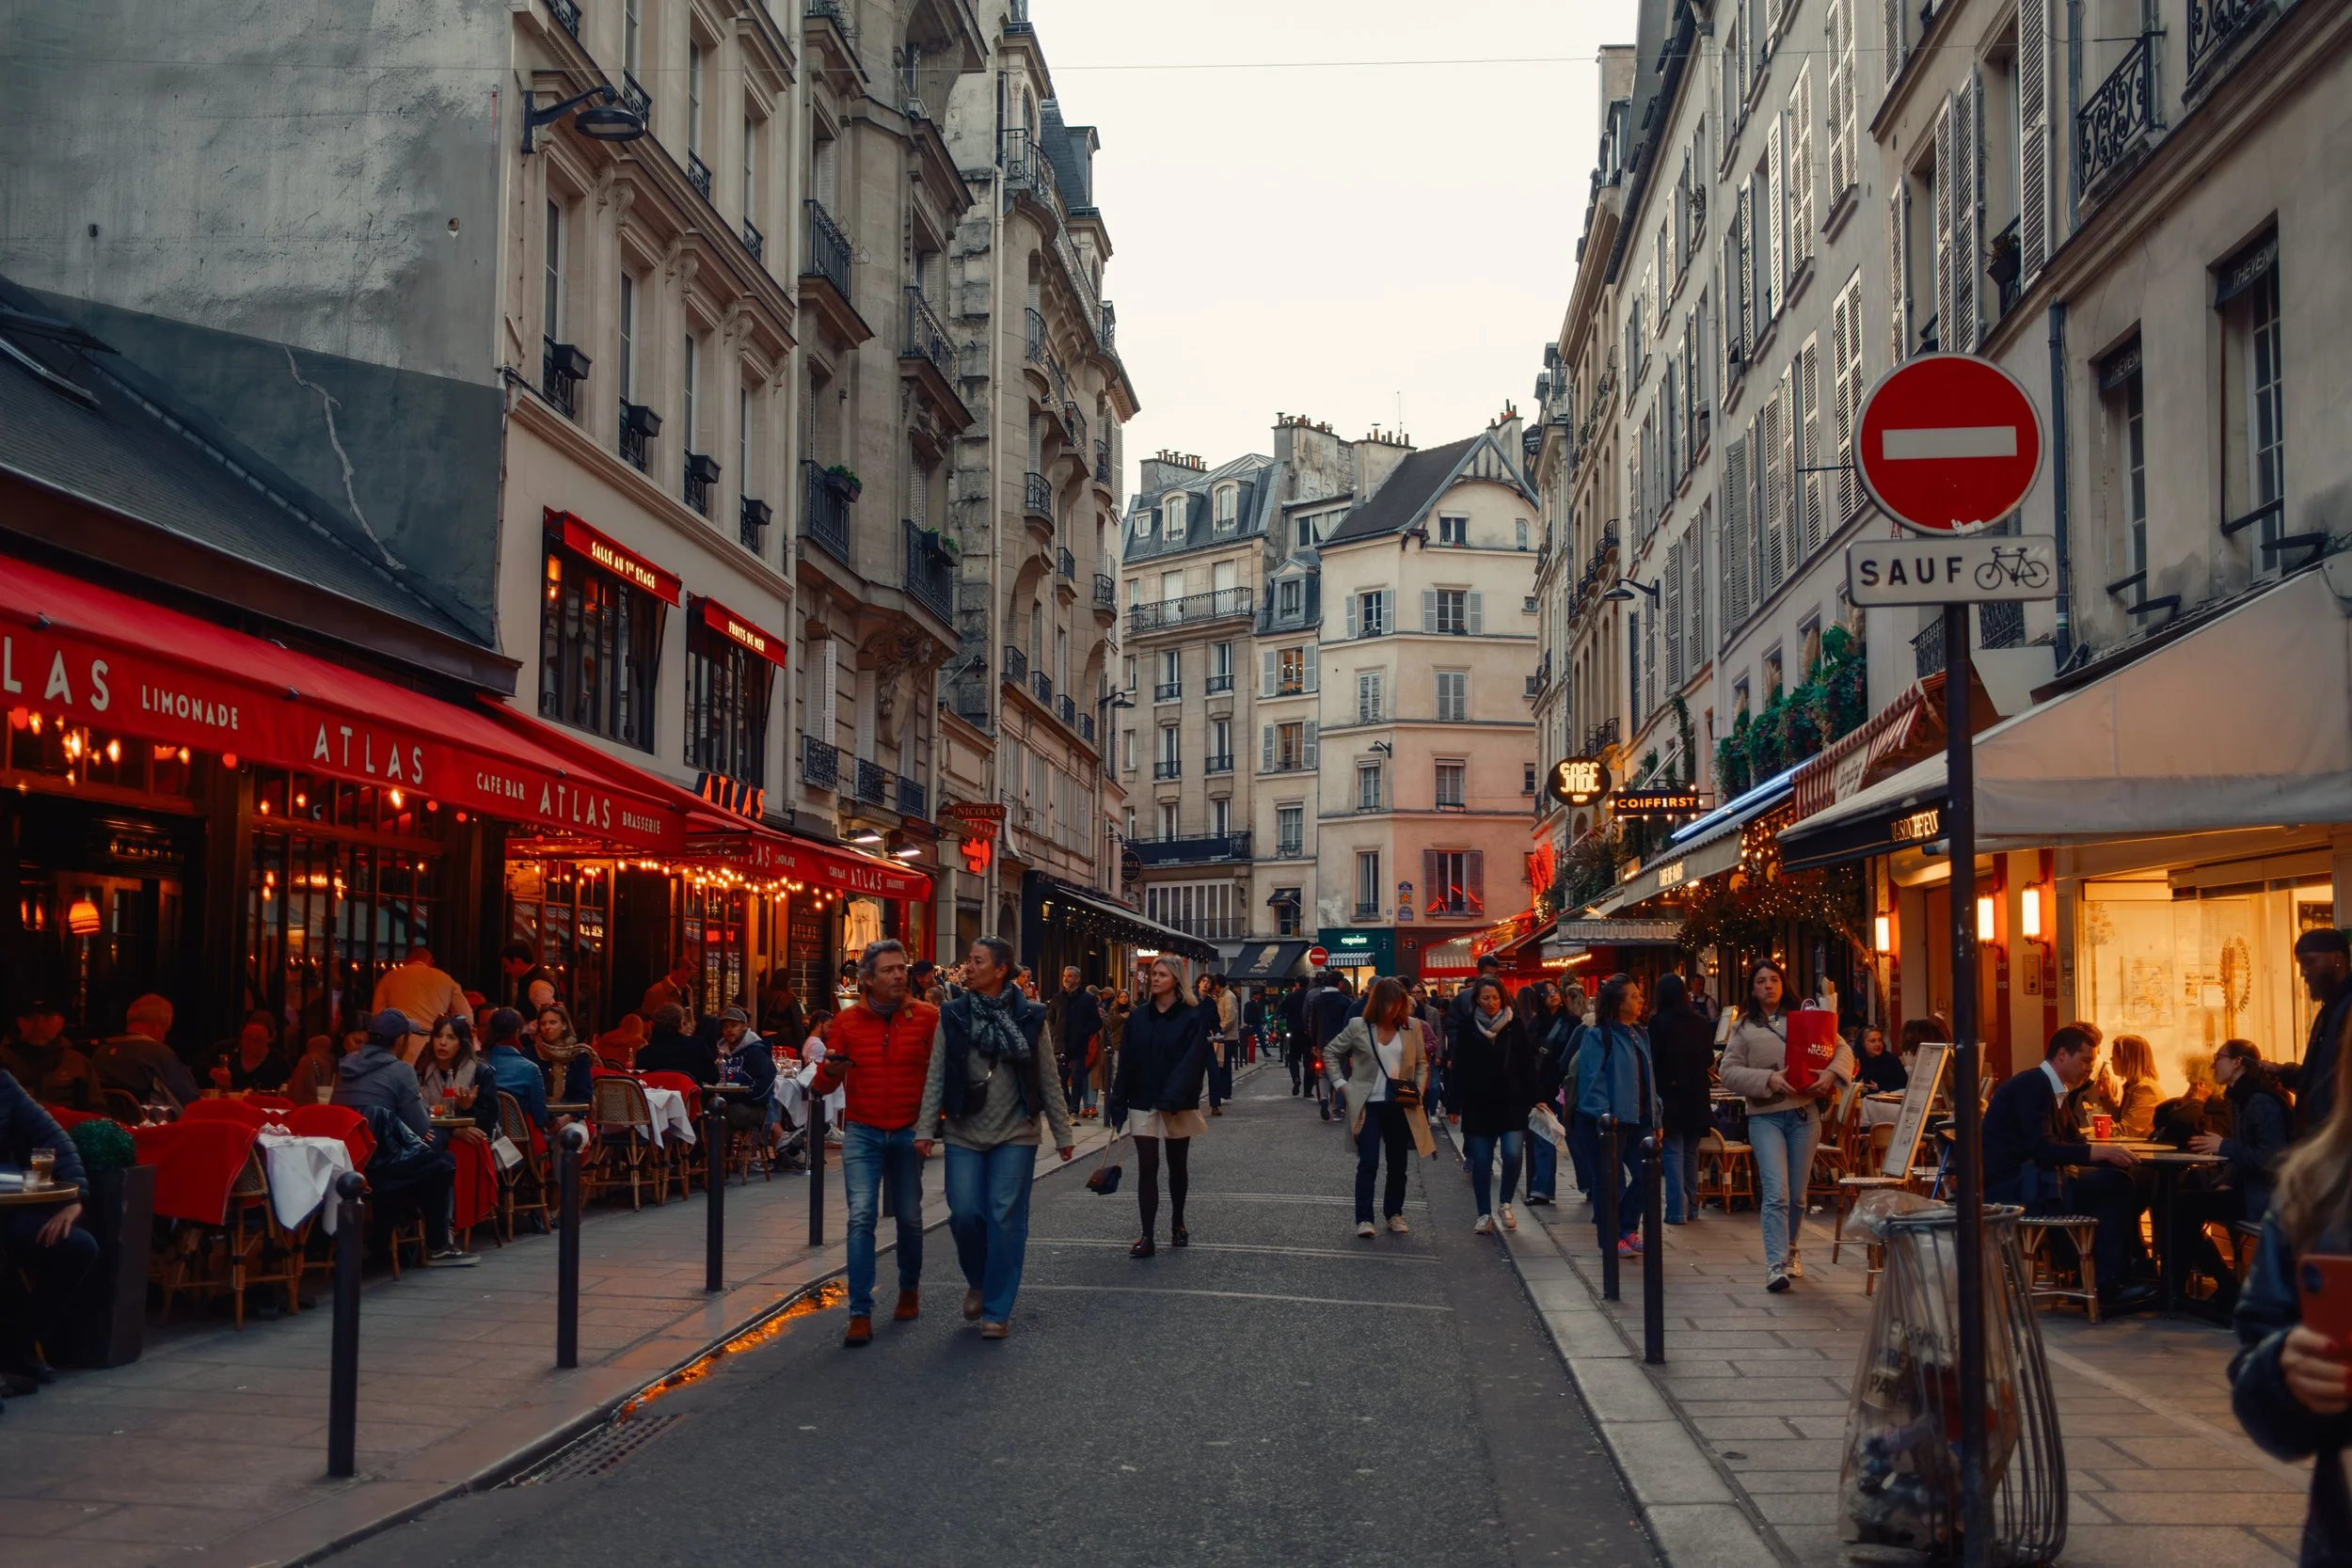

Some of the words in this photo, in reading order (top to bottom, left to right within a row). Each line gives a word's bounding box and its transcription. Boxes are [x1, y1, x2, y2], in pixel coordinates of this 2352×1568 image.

[592, 541, 612, 565] SALLE
[614, 556, 624, 572] AU
[635, 567, 656, 590] ETAGE
[1859, 556, 1963, 587] SAUF
[728, 621, 747, 641] FRUITS
[755, 636, 765, 653] MER
[3, 636, 110, 712] LAS
[141, 685, 239, 730] LIMONADE
[313, 721, 423, 784] ATLAS
[476, 771, 501, 795] CAFE
[505, 779, 525, 800] BAR
[702, 772, 765, 820] ATLAS
[539, 782, 611, 830] ATLAS
[622, 811, 661, 835] BRASSERIE
[957, 807, 1002, 816] NICOLAS
[850, 867, 882, 891] ATLAS
